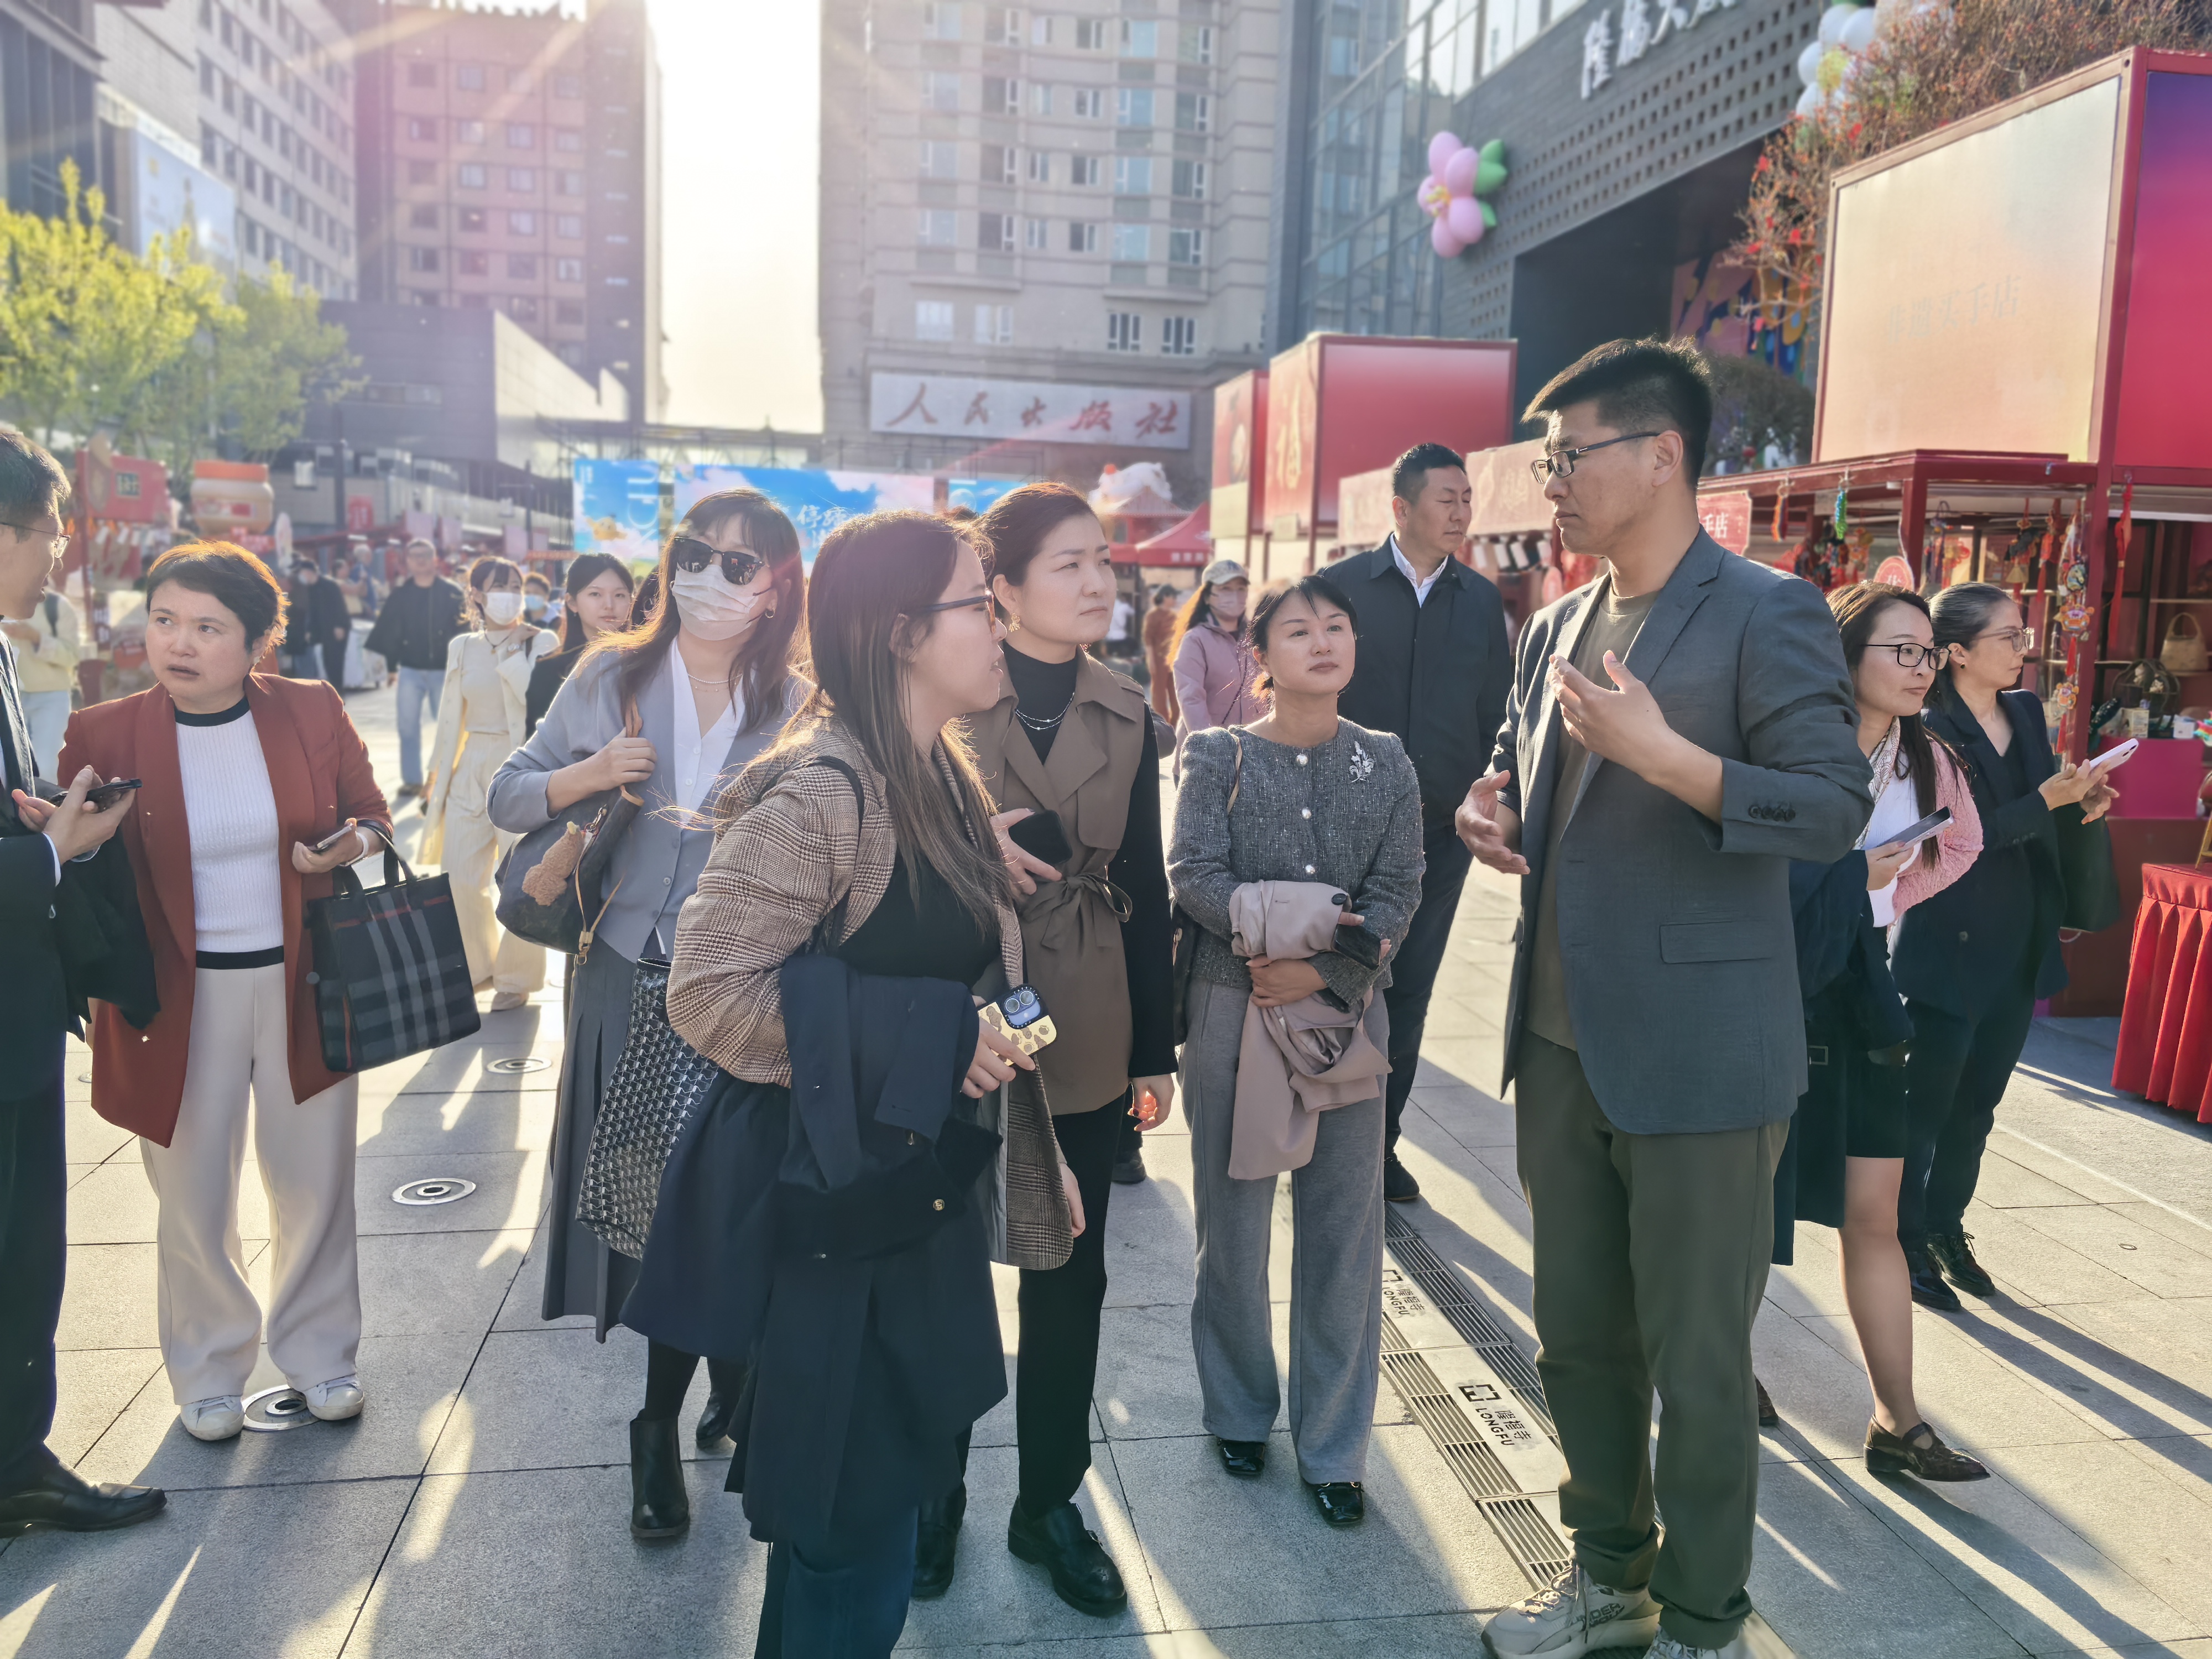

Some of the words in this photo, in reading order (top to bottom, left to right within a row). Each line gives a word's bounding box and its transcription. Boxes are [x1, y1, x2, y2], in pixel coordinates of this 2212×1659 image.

[1886, 274, 2022, 345] 非遗买手店
[885, 382, 1178, 439] 人民出版社
[1383, 1287, 1410, 1315] LONGFU
[1474, 1407, 1515, 1446] LONGFU
[1494, 1410, 1532, 1440] 隆福寺
